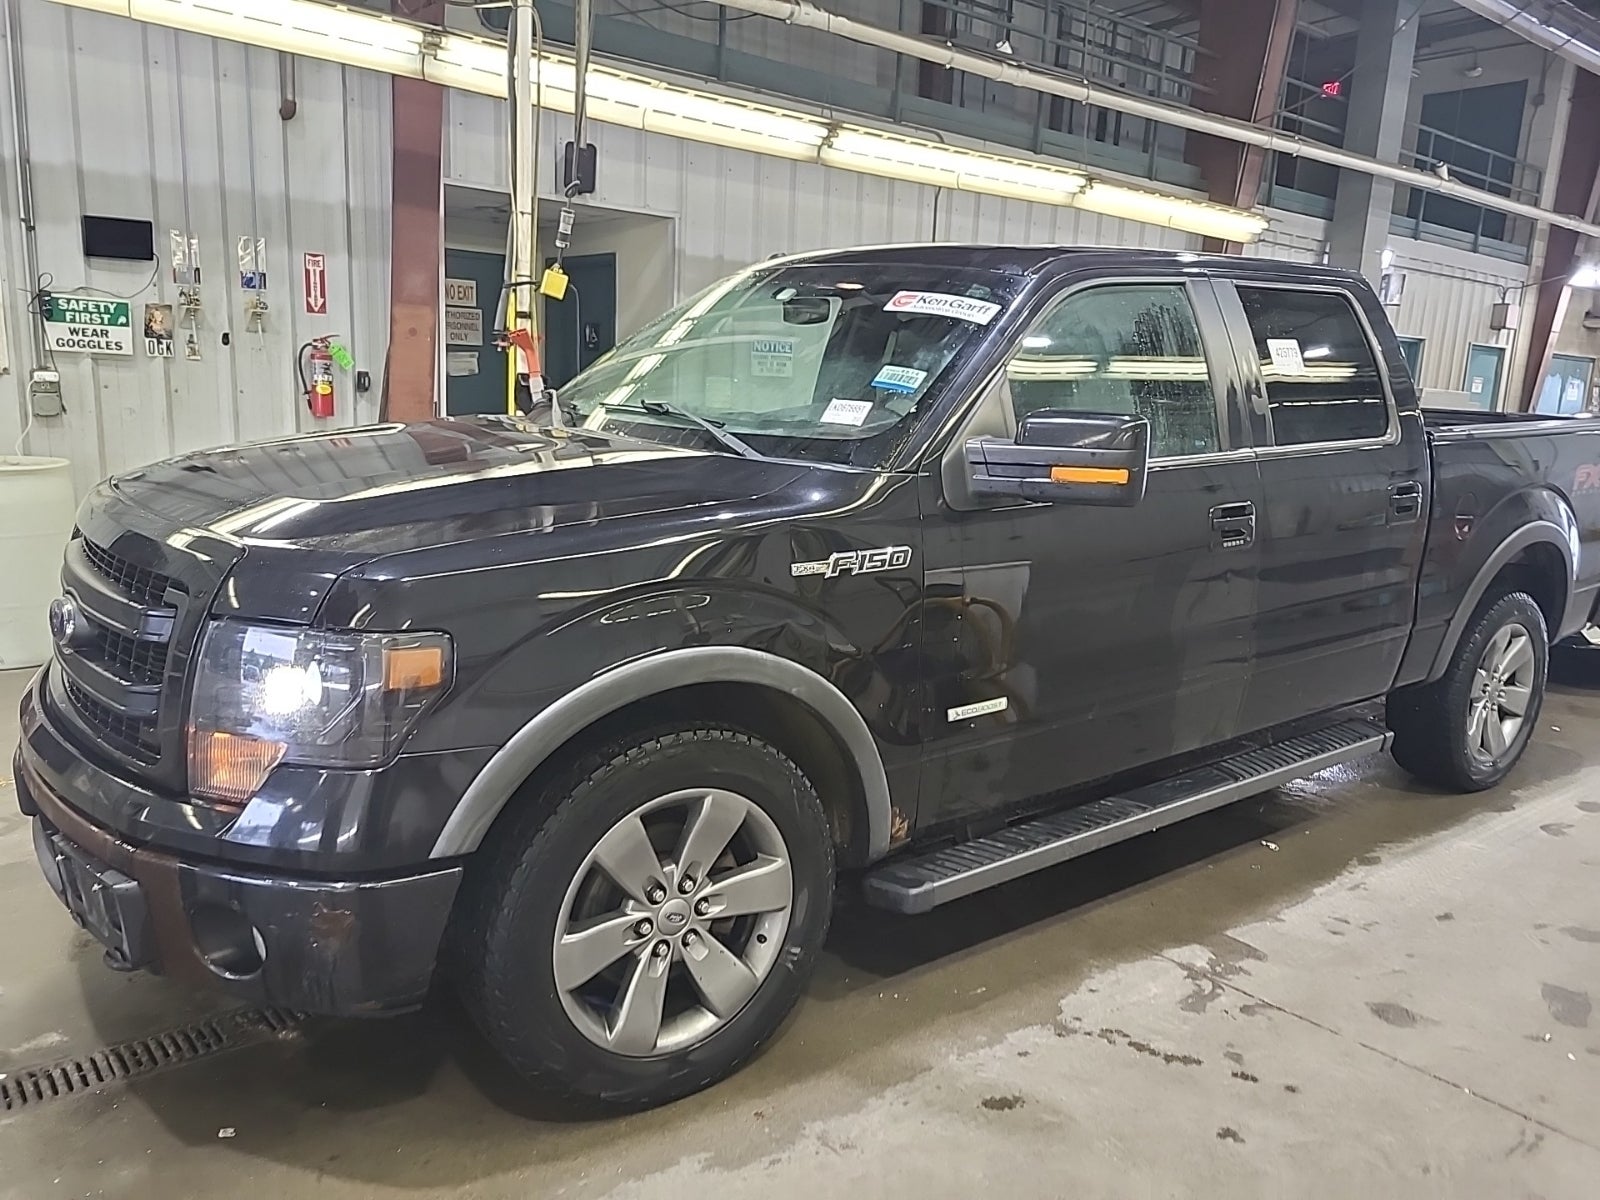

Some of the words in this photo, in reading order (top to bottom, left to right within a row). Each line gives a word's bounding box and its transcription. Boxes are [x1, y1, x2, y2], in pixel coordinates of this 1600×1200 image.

[307, 259, 321, 268] FIRE
[457, 285, 474, 301] EXIT
[58, 299, 117, 314] SAFETY
[916, 295, 947, 307] Ken
[949, 299, 992, 315] Garff
[65, 311, 111, 325] FIRST
[446, 310, 481, 321] THORIZED
[68, 327, 110, 338] WEAR
[450, 332, 469, 341] ONLY
[56, 338, 123, 351] GOGGLES
[753, 340, 792, 353] NOTICE
[824, 546, 912, 579] F-150
